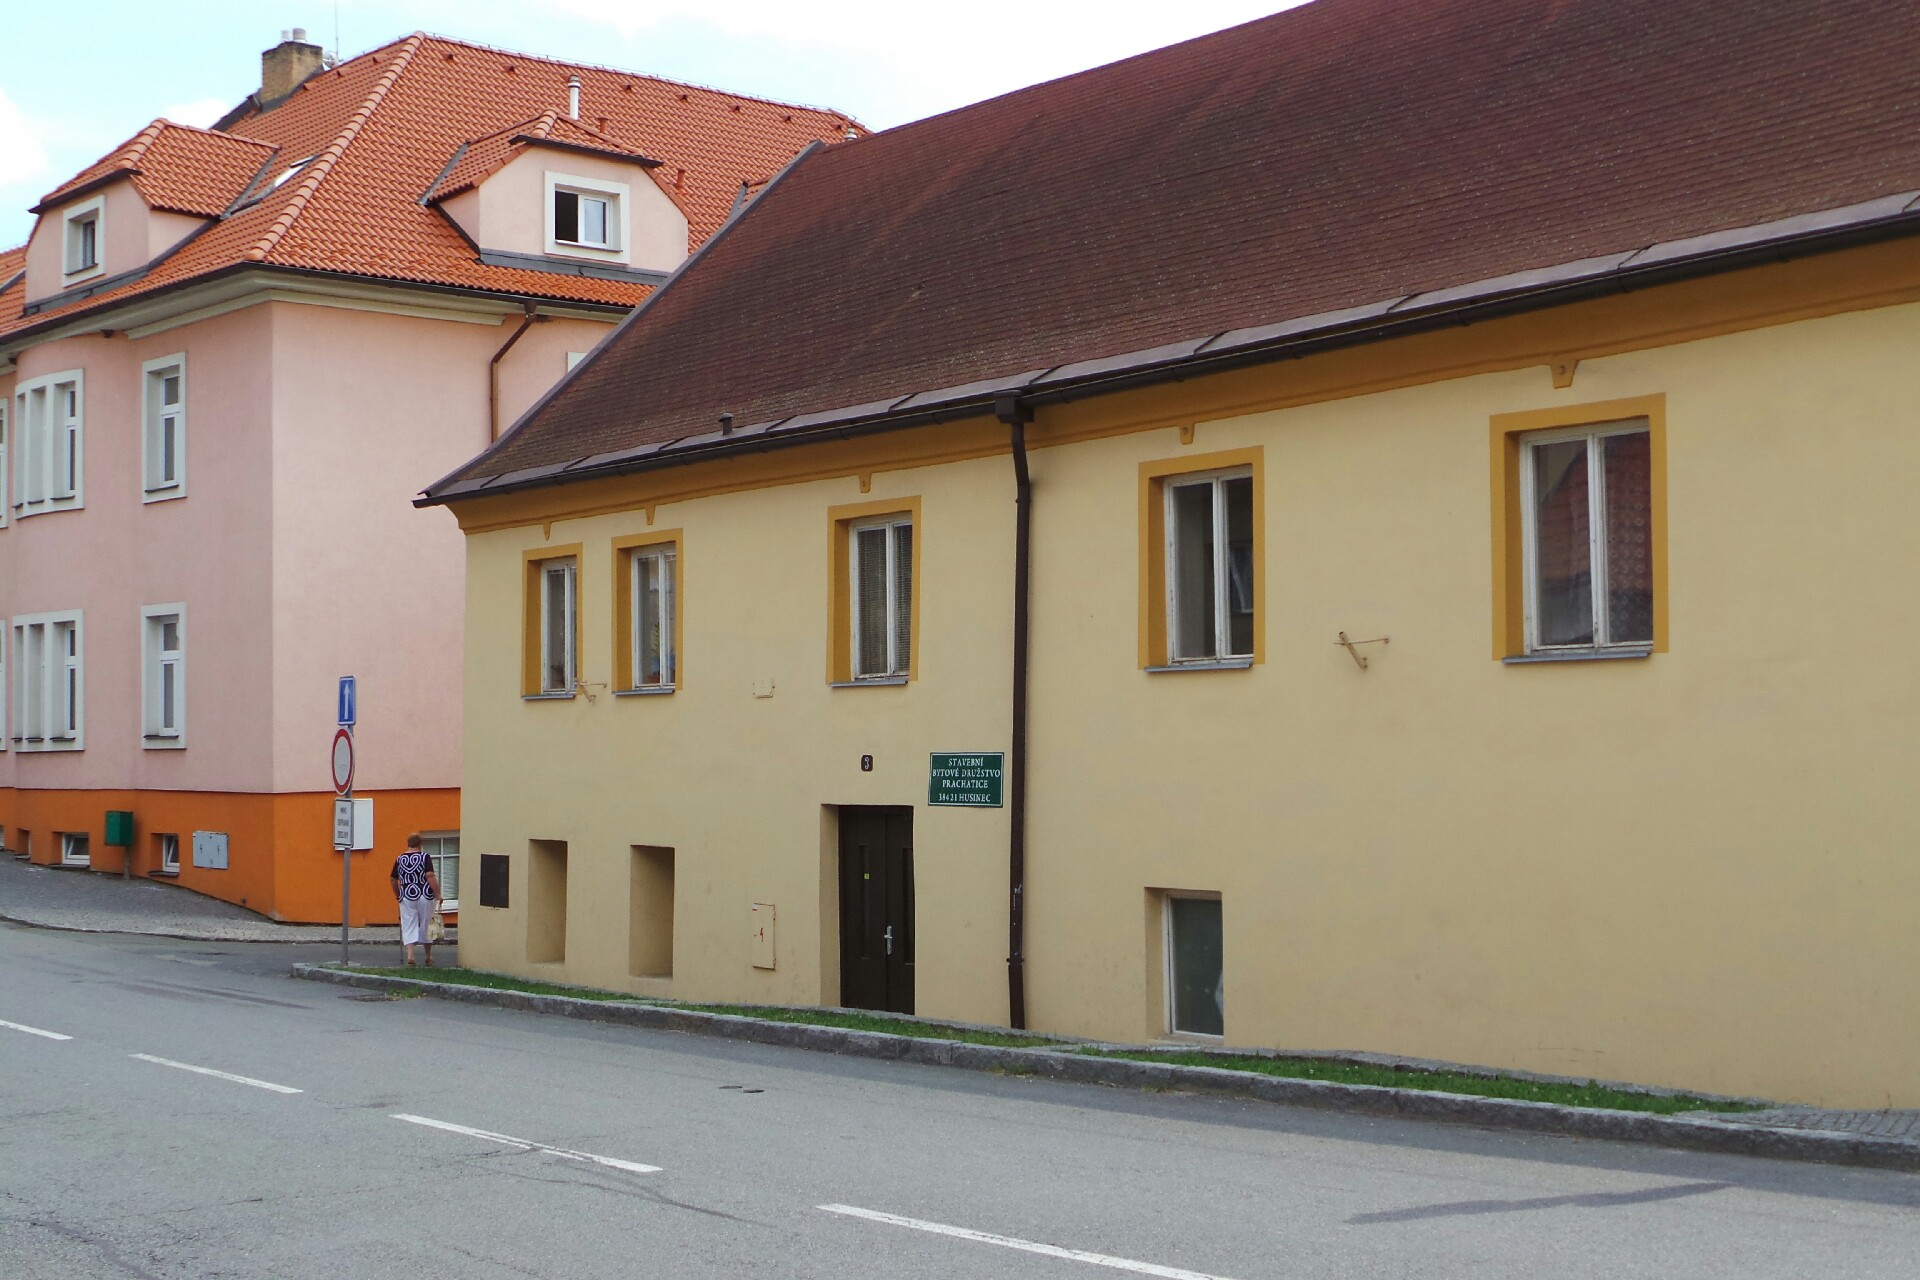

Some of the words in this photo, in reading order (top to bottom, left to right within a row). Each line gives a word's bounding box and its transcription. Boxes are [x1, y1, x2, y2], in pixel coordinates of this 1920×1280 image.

[948, 756, 984, 767] STAVEBNÍ
[932, 767, 960, 777] BYTOVÉ
[961, 767, 1001, 778] DRUŽSTVO
[942, 779, 989, 789] PRACHATICE
[958, 793, 991, 802] HUSINEC
